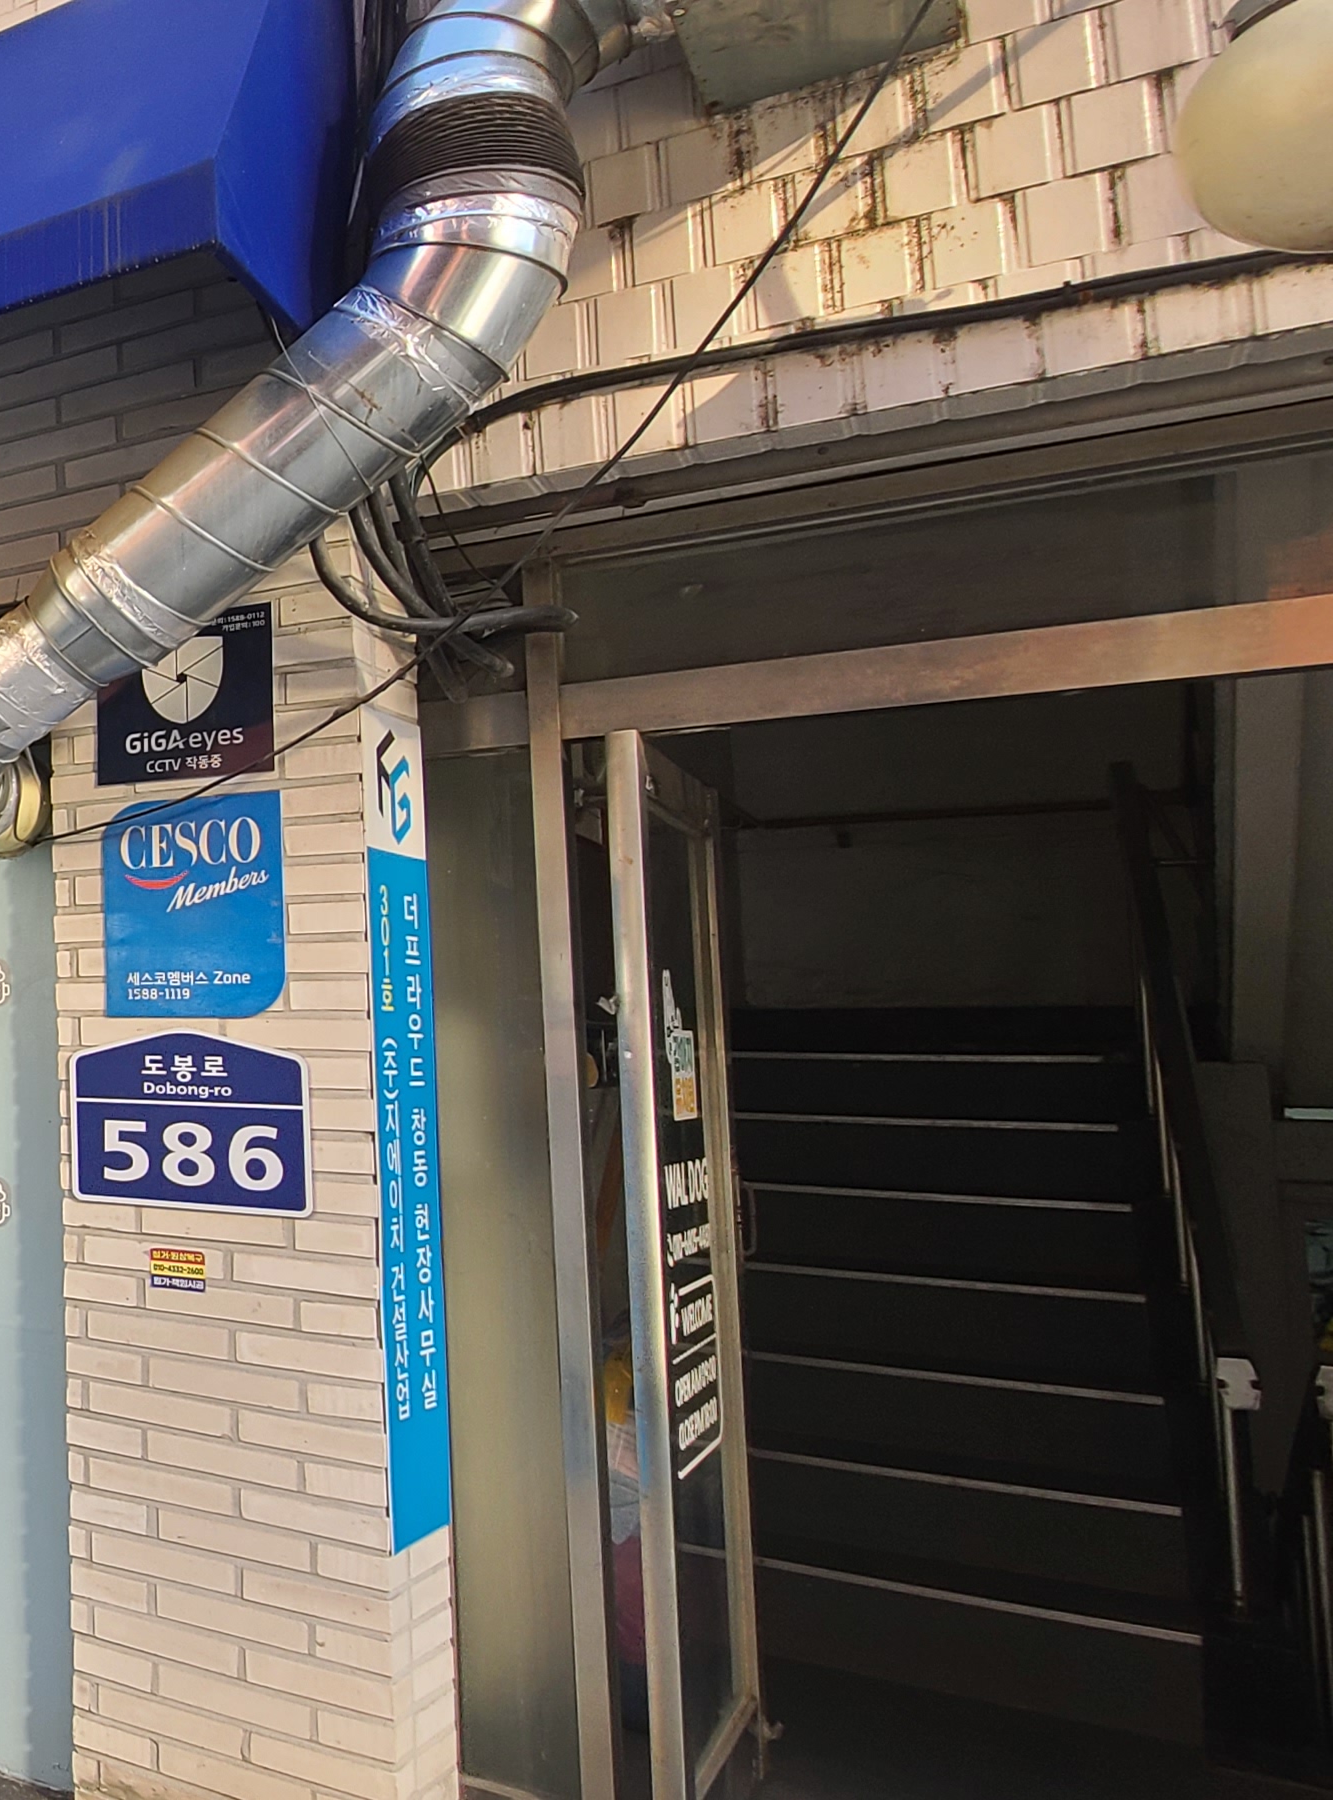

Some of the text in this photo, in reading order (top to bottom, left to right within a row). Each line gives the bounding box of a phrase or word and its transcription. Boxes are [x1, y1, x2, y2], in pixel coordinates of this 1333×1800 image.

[146, 753, 223, 773] CCTV 작동중
[119, 816, 261, 872] CESCO
[166, 868, 269, 912] Members
[379, 884, 395, 1012] 301호
[127, 970, 251, 986] 세스코멤버스 Zone
[127, 987, 190, 1000] 1588-1119
[141, 1054, 228, 1081] 도봉로
[143, 1080, 232, 1097] Dobong-ro
[103, 1119, 284, 1191] 586
[403, 893, 438, 1410] 더프라우드 창동 현장사무실
[381, 1037, 410, 1421] (주)지에이치 건설산업
[681, 1294, 713, 1337] WELCOME
